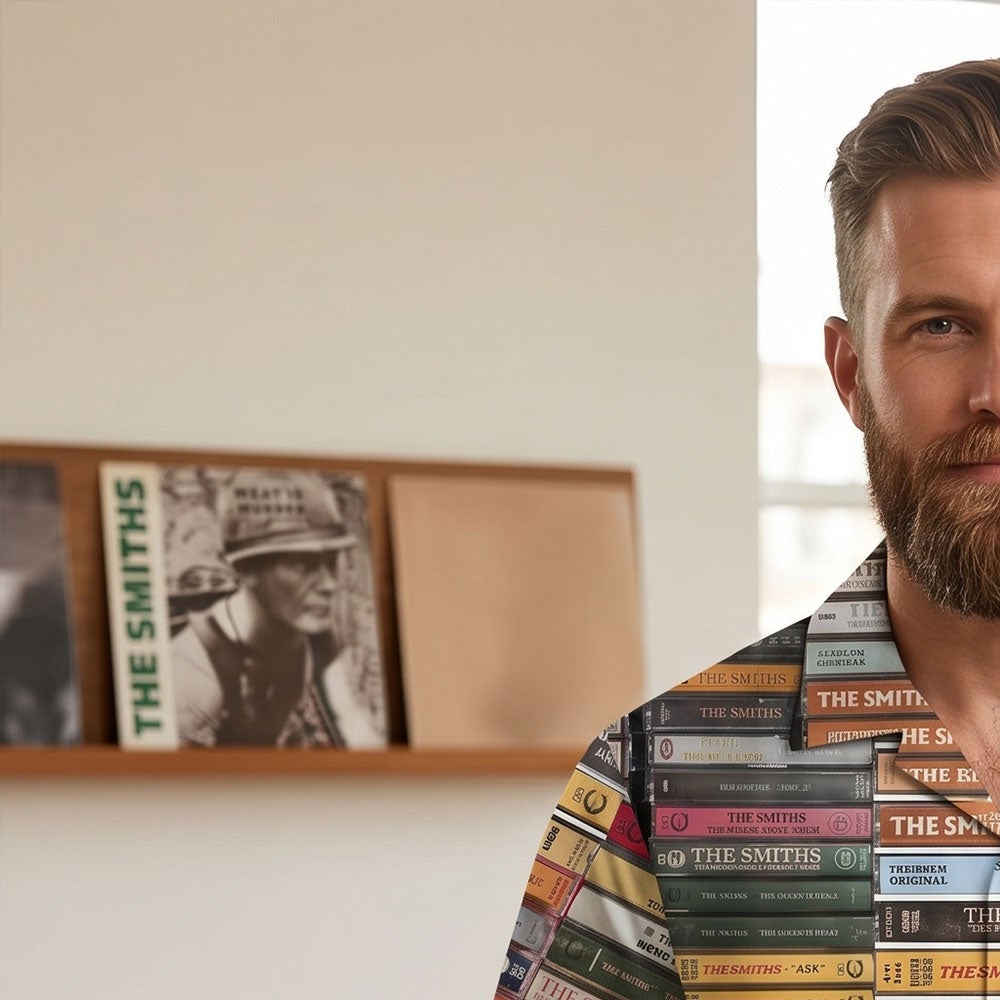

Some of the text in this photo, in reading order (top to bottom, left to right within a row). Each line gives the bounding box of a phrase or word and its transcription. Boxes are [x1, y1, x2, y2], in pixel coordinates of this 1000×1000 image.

[114, 477, 161, 738] THE SMITHS
[698, 672, 787, 685] THE SMITHS
[817, 691, 861, 708] THE
[699, 707, 782, 719] THE SMITHS
[901, 728, 930, 745] HE
[727, 812, 807, 823] THE SMITHS
[889, 816, 939, 835] THE
[691, 848, 821, 864] THE SMITHS
[889, 876, 948, 885] ORIGINAL
[703, 964, 782, 975] THESMITHS
